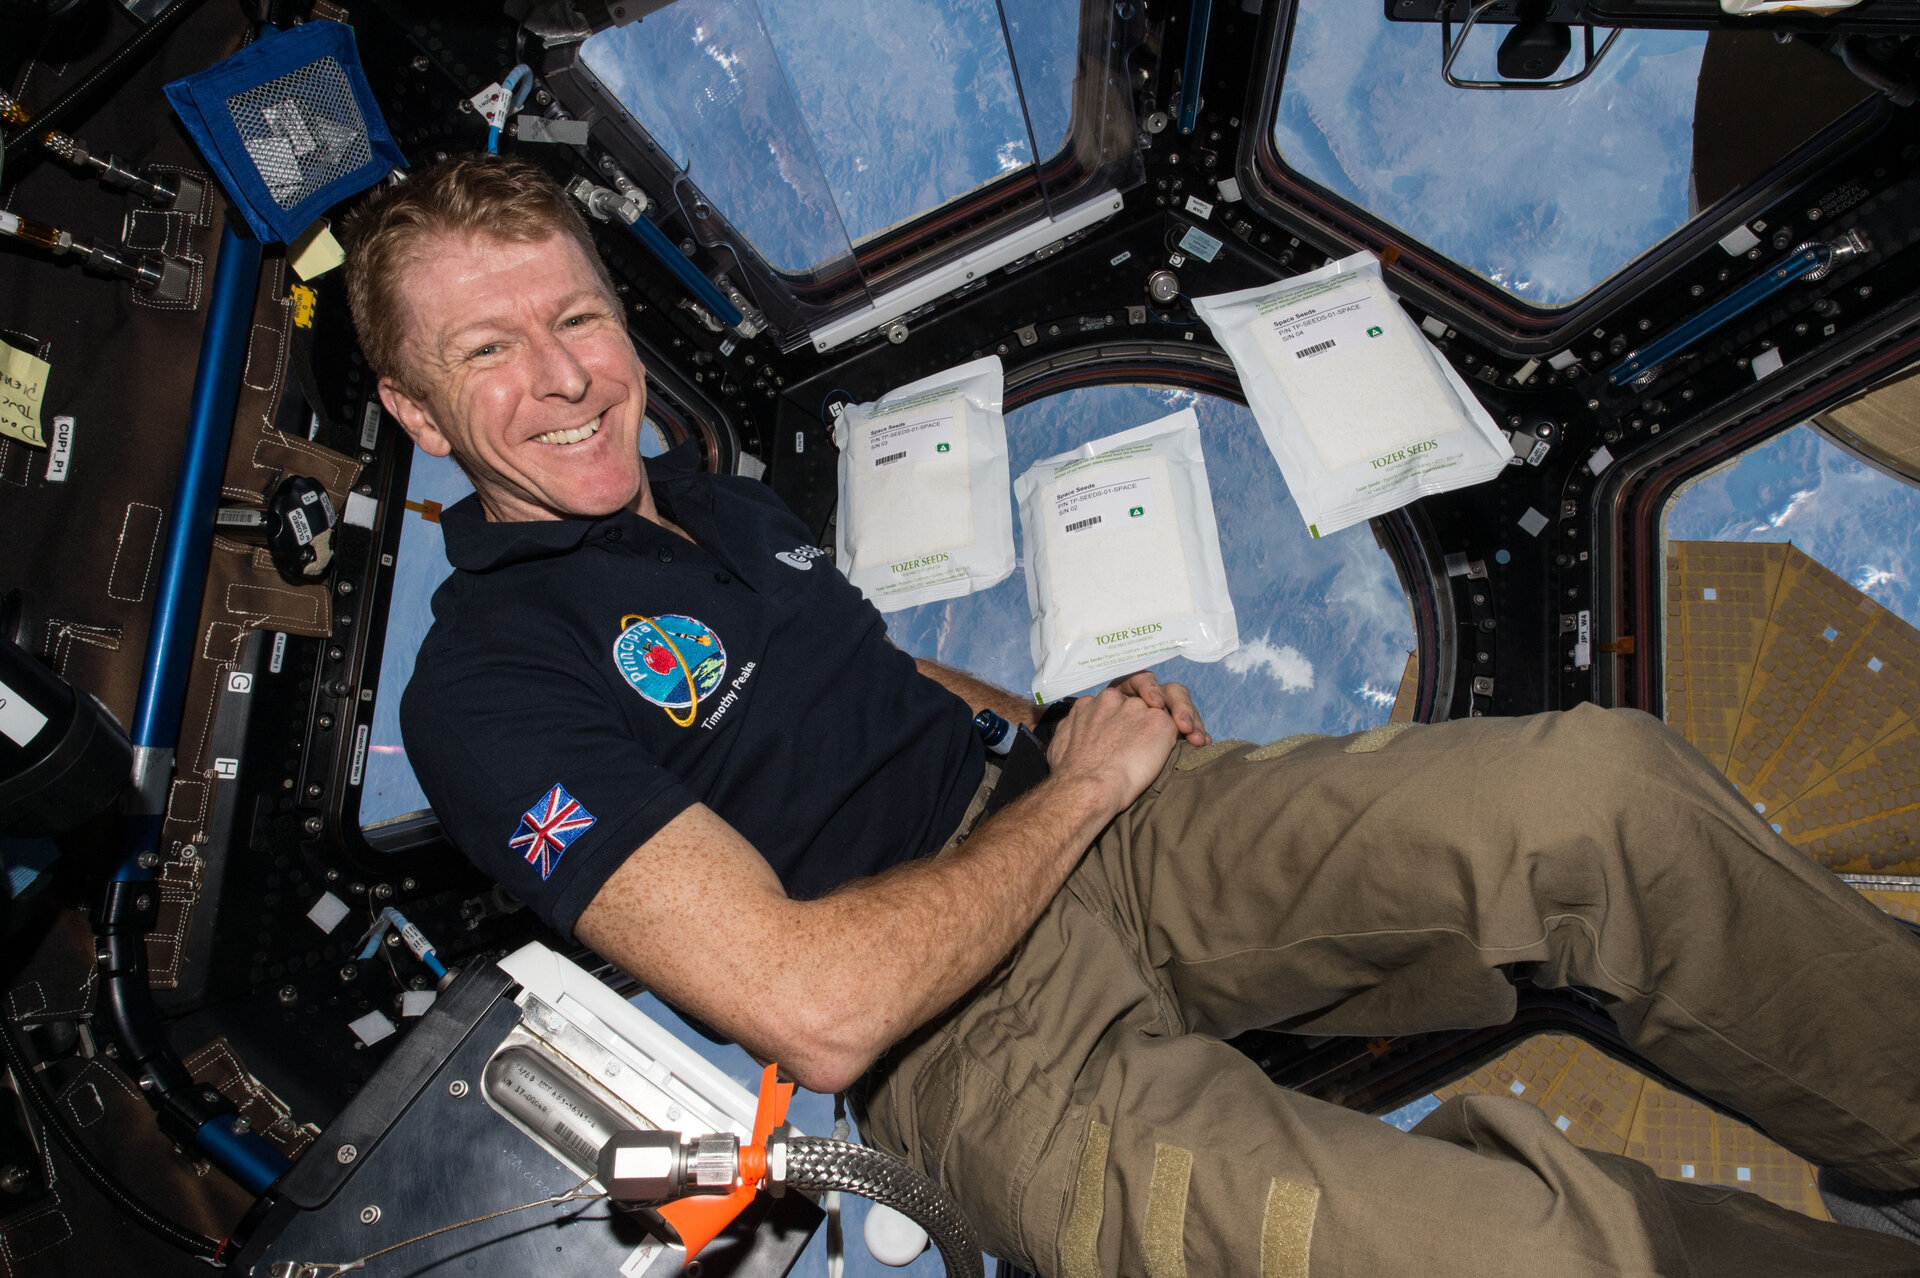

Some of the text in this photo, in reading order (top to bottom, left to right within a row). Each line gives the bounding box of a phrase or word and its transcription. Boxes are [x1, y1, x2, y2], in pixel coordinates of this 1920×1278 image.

[1172, 254, 1183, 265] G
[1274, 308, 1316, 328] Space Seeds
[1278, 304, 1362, 336] P/N TP-SEEDS-01-SPACE
[1282, 334, 1295, 342] S/N
[831, 402, 842, 415] H
[870, 422, 906, 436] Space Seeds
[881, 422, 940, 440] TP-SEEDS-01-SPACE
[53, 424, 69, 473] CUP1_P1
[1370, 450, 1406, 470] TOZER
[1407, 440, 1438, 457] SEEDS
[1056, 483, 1095, 500] Space Seeds
[1058, 483, 1137, 509] P/N TP-SEEDS-01-SPACE
[296, 510, 302, 519] OP
[1058, 508, 1069, 516] S/N
[292, 516, 304, 540] CLOSED
[890, 559, 919, 574] TOZER
[921, 552, 949, 567] SEEDS
[1096, 630, 1128, 645] TOZER
[1131, 622, 1162, 637] SEEDS
[231, 674, 250, 690] G
[701, 661, 756, 730] Timothy Peake
[218, 761, 237, 775] H
